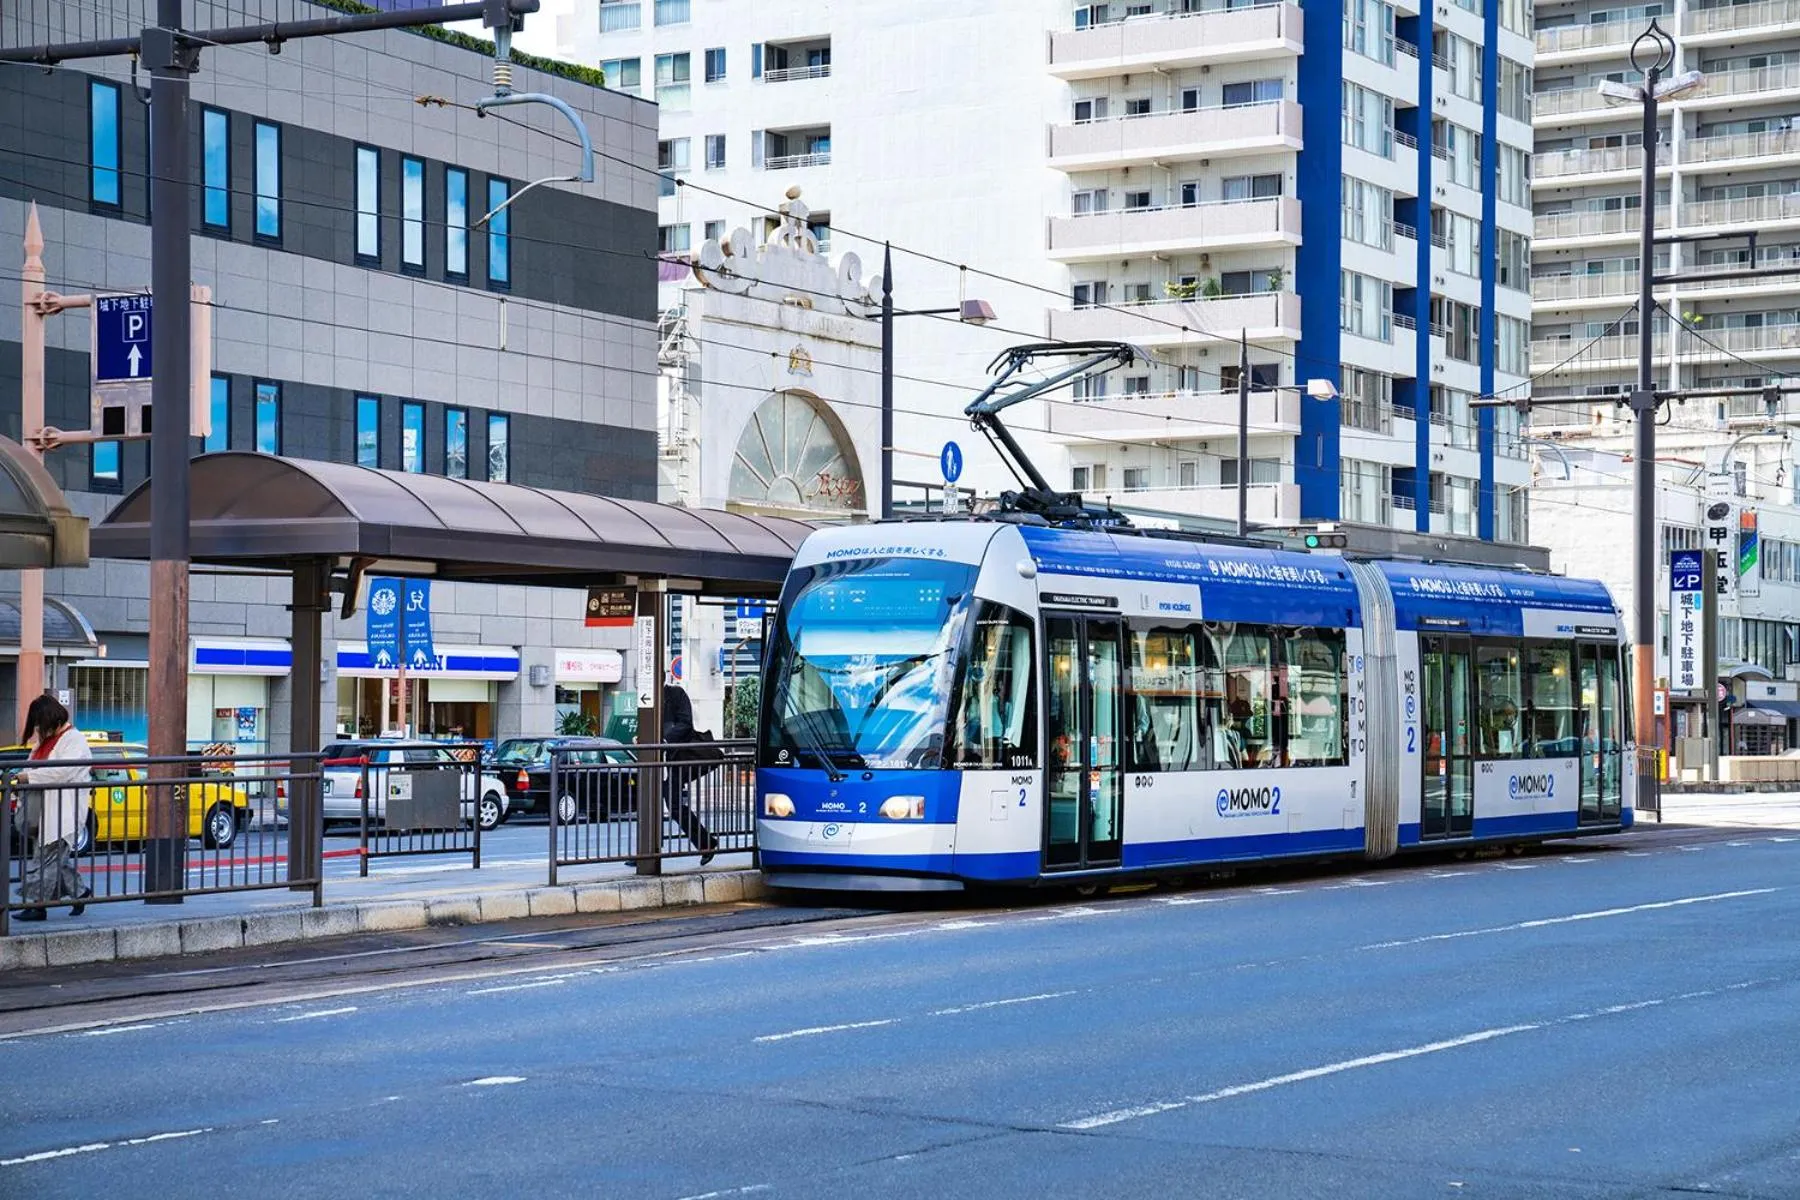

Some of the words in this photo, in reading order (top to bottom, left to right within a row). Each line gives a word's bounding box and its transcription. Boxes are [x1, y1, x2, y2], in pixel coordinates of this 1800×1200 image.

[100, 297, 152, 312] 城下地下駐
[128, 315, 144, 339] P
[1687, 575, 1700, 588] P
[1680, 593, 1694, 687] 城下地下駐車場
[1407, 726, 1416, 753] 2
[1011, 775, 1033, 785] MOMO
[1019, 788, 1027, 807] 2
[821, 802, 845, 810] MOMO
[859, 802, 867, 813] 2
